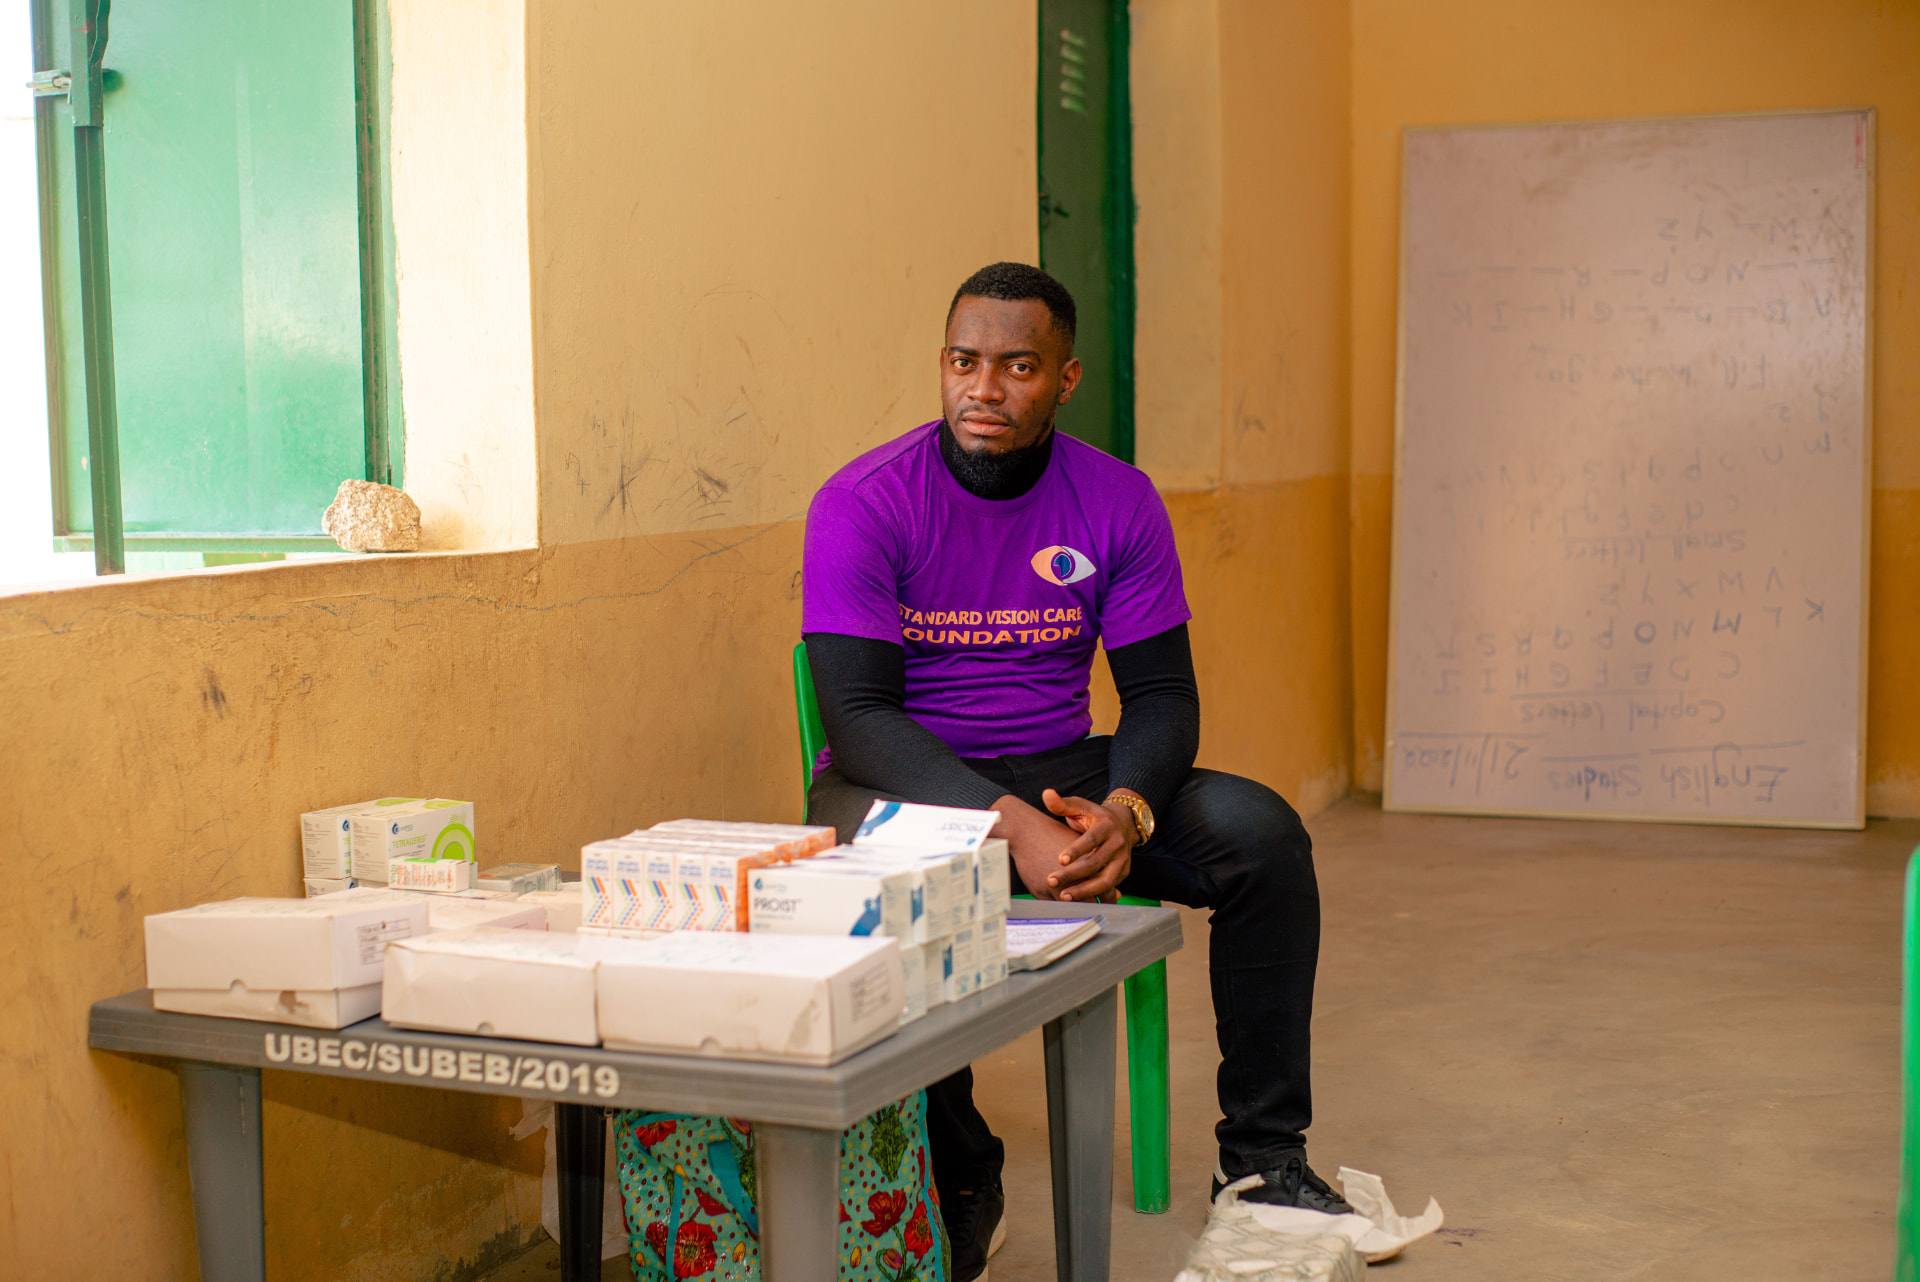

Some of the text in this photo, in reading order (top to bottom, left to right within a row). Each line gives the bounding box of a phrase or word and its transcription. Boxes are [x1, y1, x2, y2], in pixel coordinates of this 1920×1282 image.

[901, 623, 1081, 645] OUNDATION
[986, 609, 1039, 625] VISION
[1044, 606, 1083, 623] CARE
[1547, 765, 1642, 803] Studies
[1661, 743, 1789, 807] English
[264, 1033, 621, 1098] UBEC/SUBEB/2019
